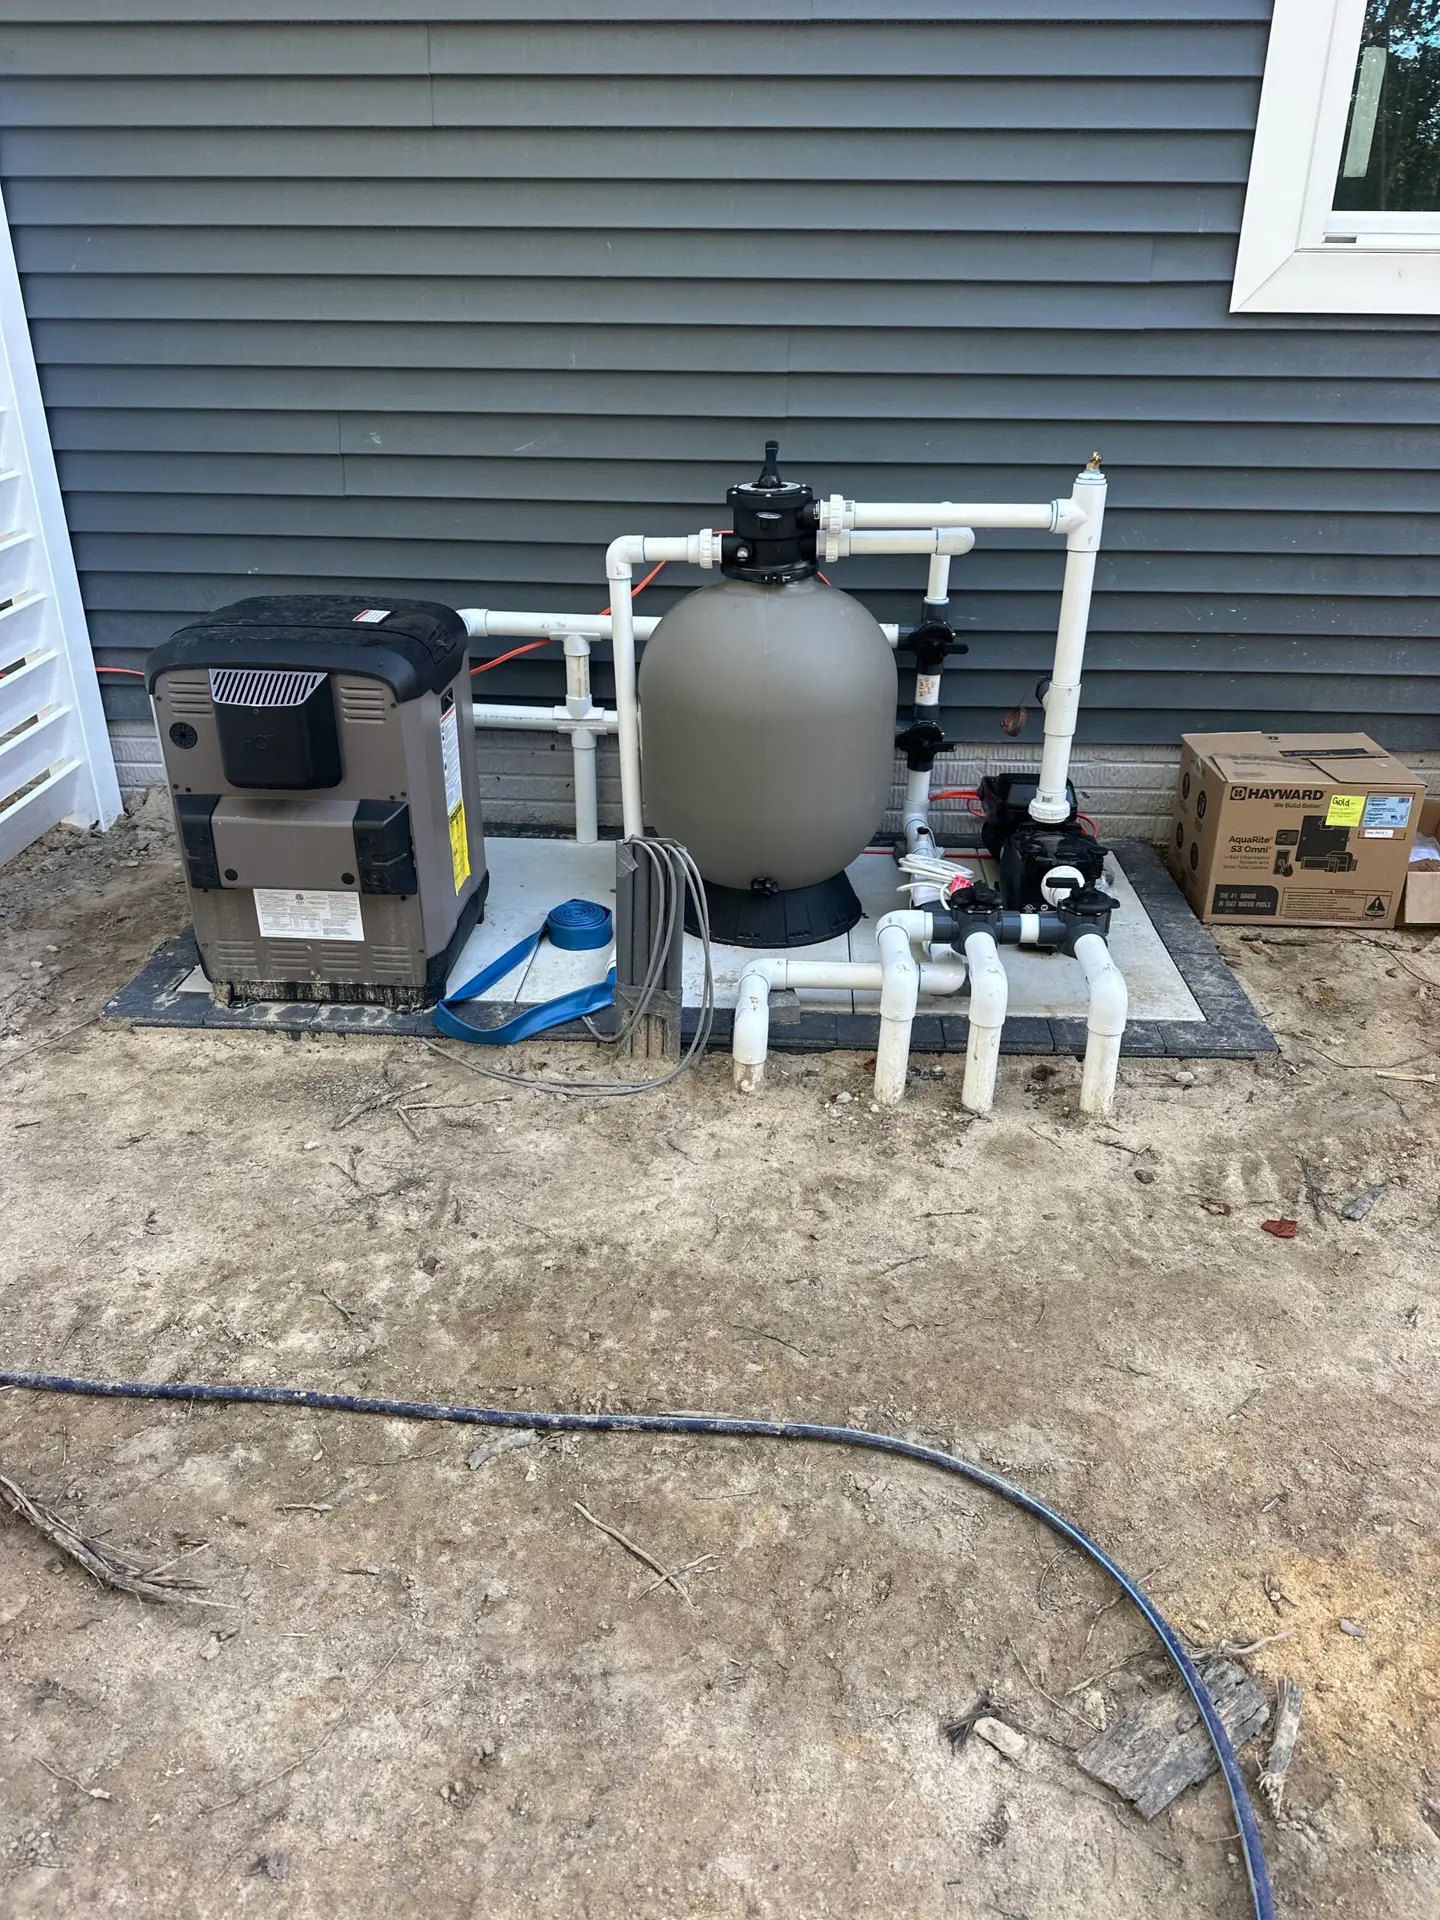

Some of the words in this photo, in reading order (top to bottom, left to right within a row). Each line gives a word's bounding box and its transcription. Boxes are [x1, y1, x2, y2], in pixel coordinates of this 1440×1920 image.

[1248, 788, 1324, 801] HAYWARD
[1332, 796, 1350, 807] Gold
[1230, 845, 1242, 853] S3
[1238, 900, 1254, 908] WATER
